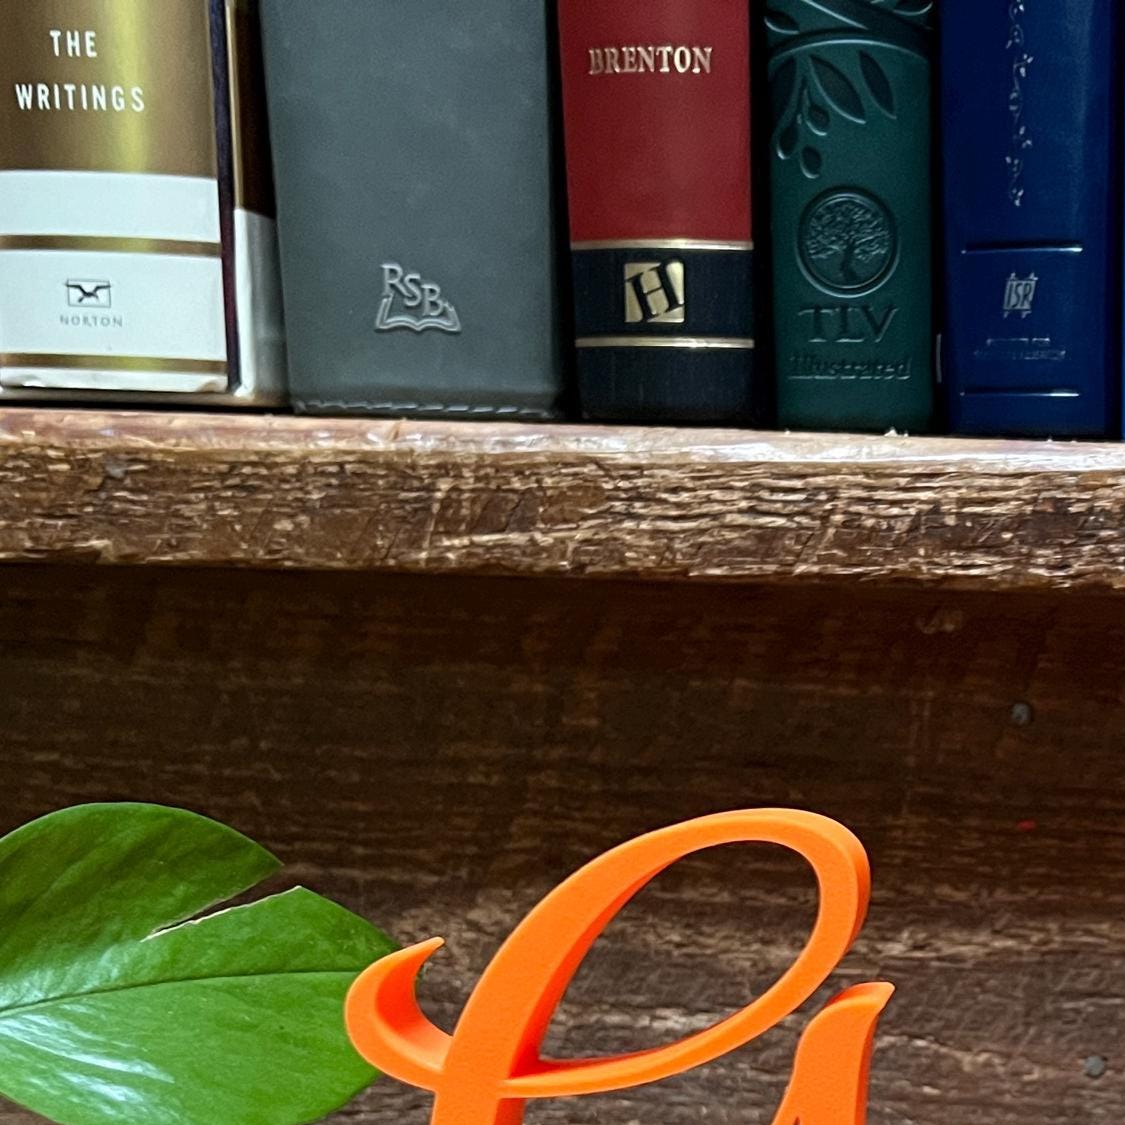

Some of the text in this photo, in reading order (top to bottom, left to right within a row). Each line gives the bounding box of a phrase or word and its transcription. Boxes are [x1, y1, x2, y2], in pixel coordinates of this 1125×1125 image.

[50, 29, 97, 58] THE
[588, 46, 713, 75] BRENTON
[15, 83, 146, 112] WRITINGS
[379, 262, 445, 317] RSB
[59, 314, 124, 328] NORTON
[798, 303, 900, 343] TLV
